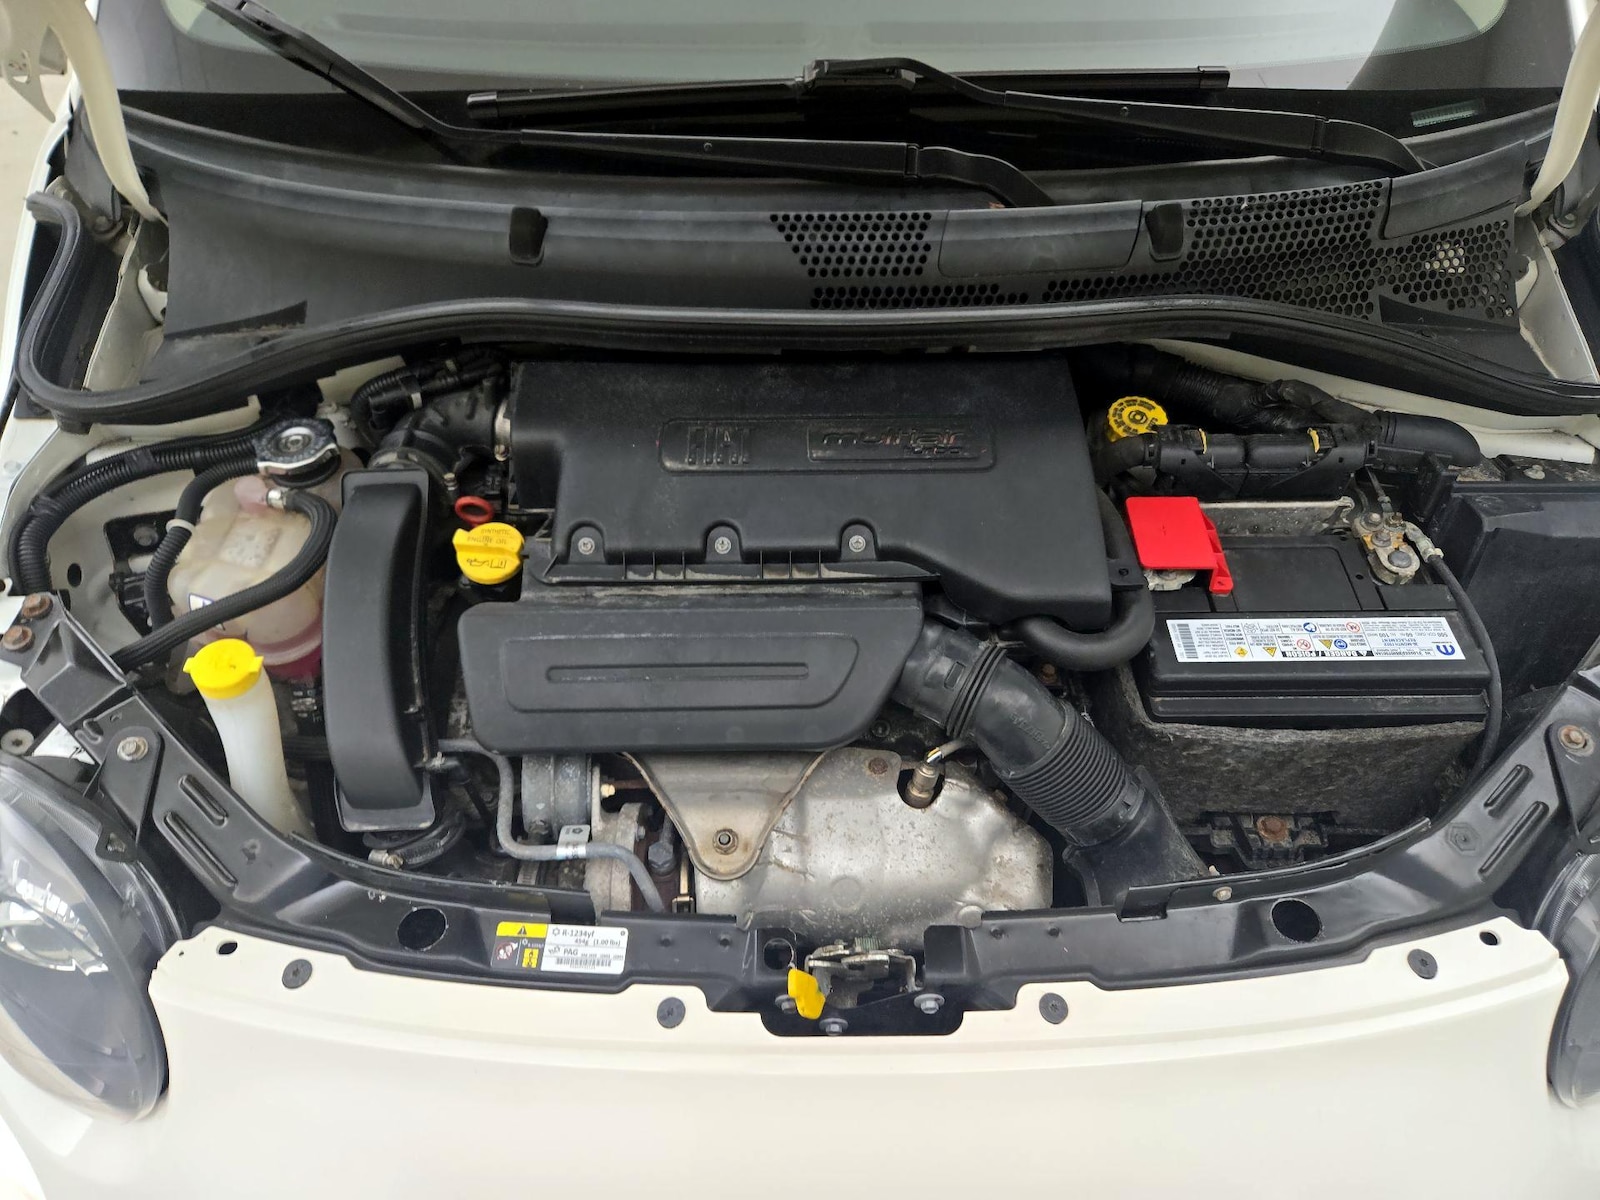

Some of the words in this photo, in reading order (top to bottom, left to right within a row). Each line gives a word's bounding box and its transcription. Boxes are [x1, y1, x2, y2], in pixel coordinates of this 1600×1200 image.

[685, 426, 752, 465] FIAT
[561, 929, 595, 938] R-1234yf
[563, 948, 579, 956] PAG
